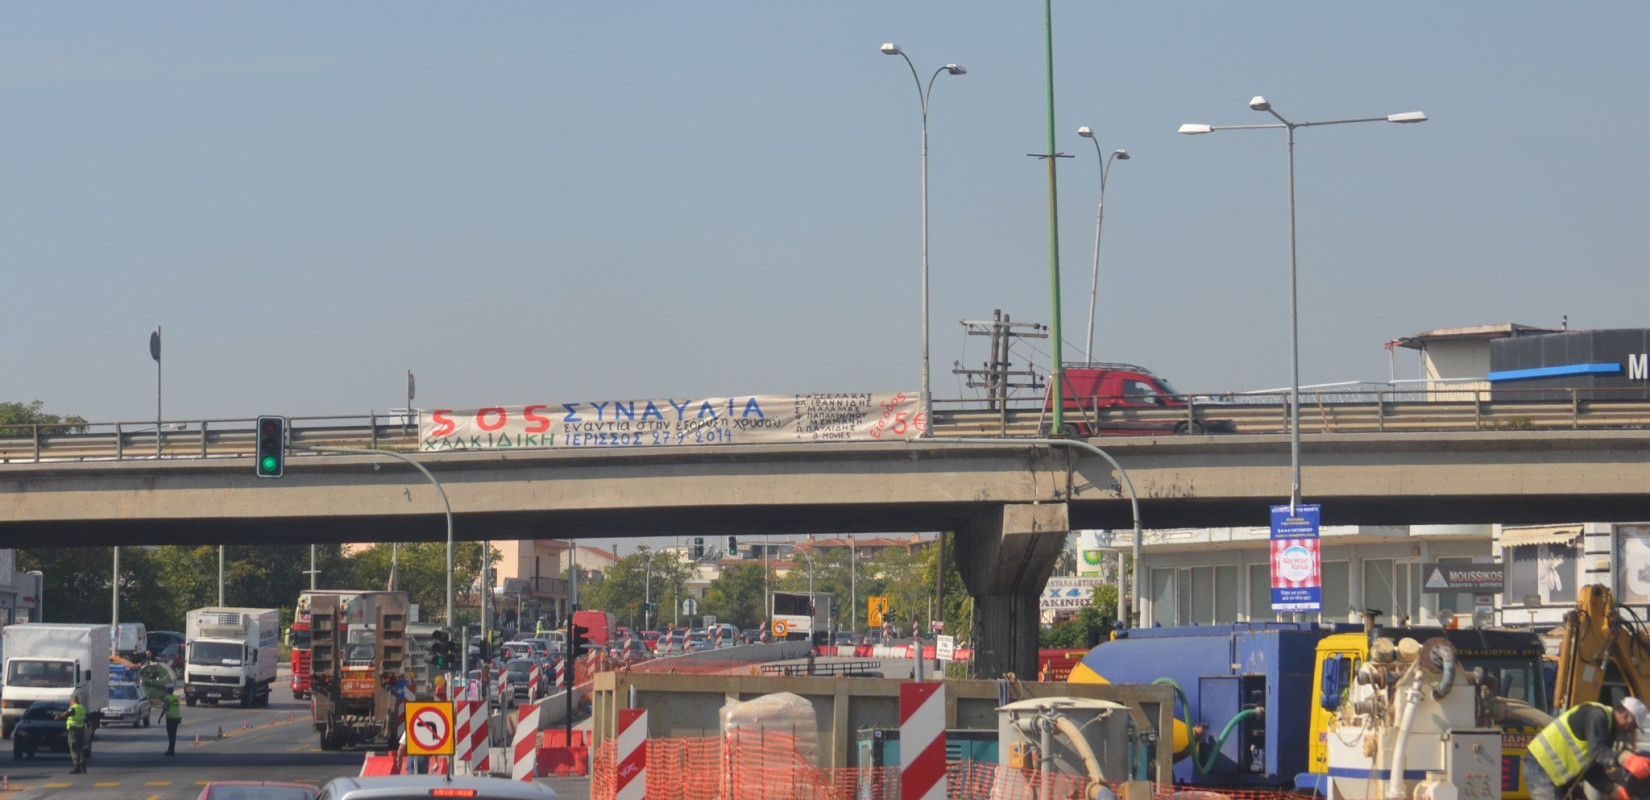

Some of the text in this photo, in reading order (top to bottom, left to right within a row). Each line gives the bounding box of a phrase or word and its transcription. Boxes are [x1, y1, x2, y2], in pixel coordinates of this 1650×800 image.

[1628, 353, 1648, 379] M
[431, 404, 551, 437] SOS
[562, 397, 765, 422] ΣΥΝΑΥΛΙΑ
[565, 431, 644, 446] ΙΕΡΙΣΣΟΣ
[1449, 570, 1503, 582] MOUSSIKOS
